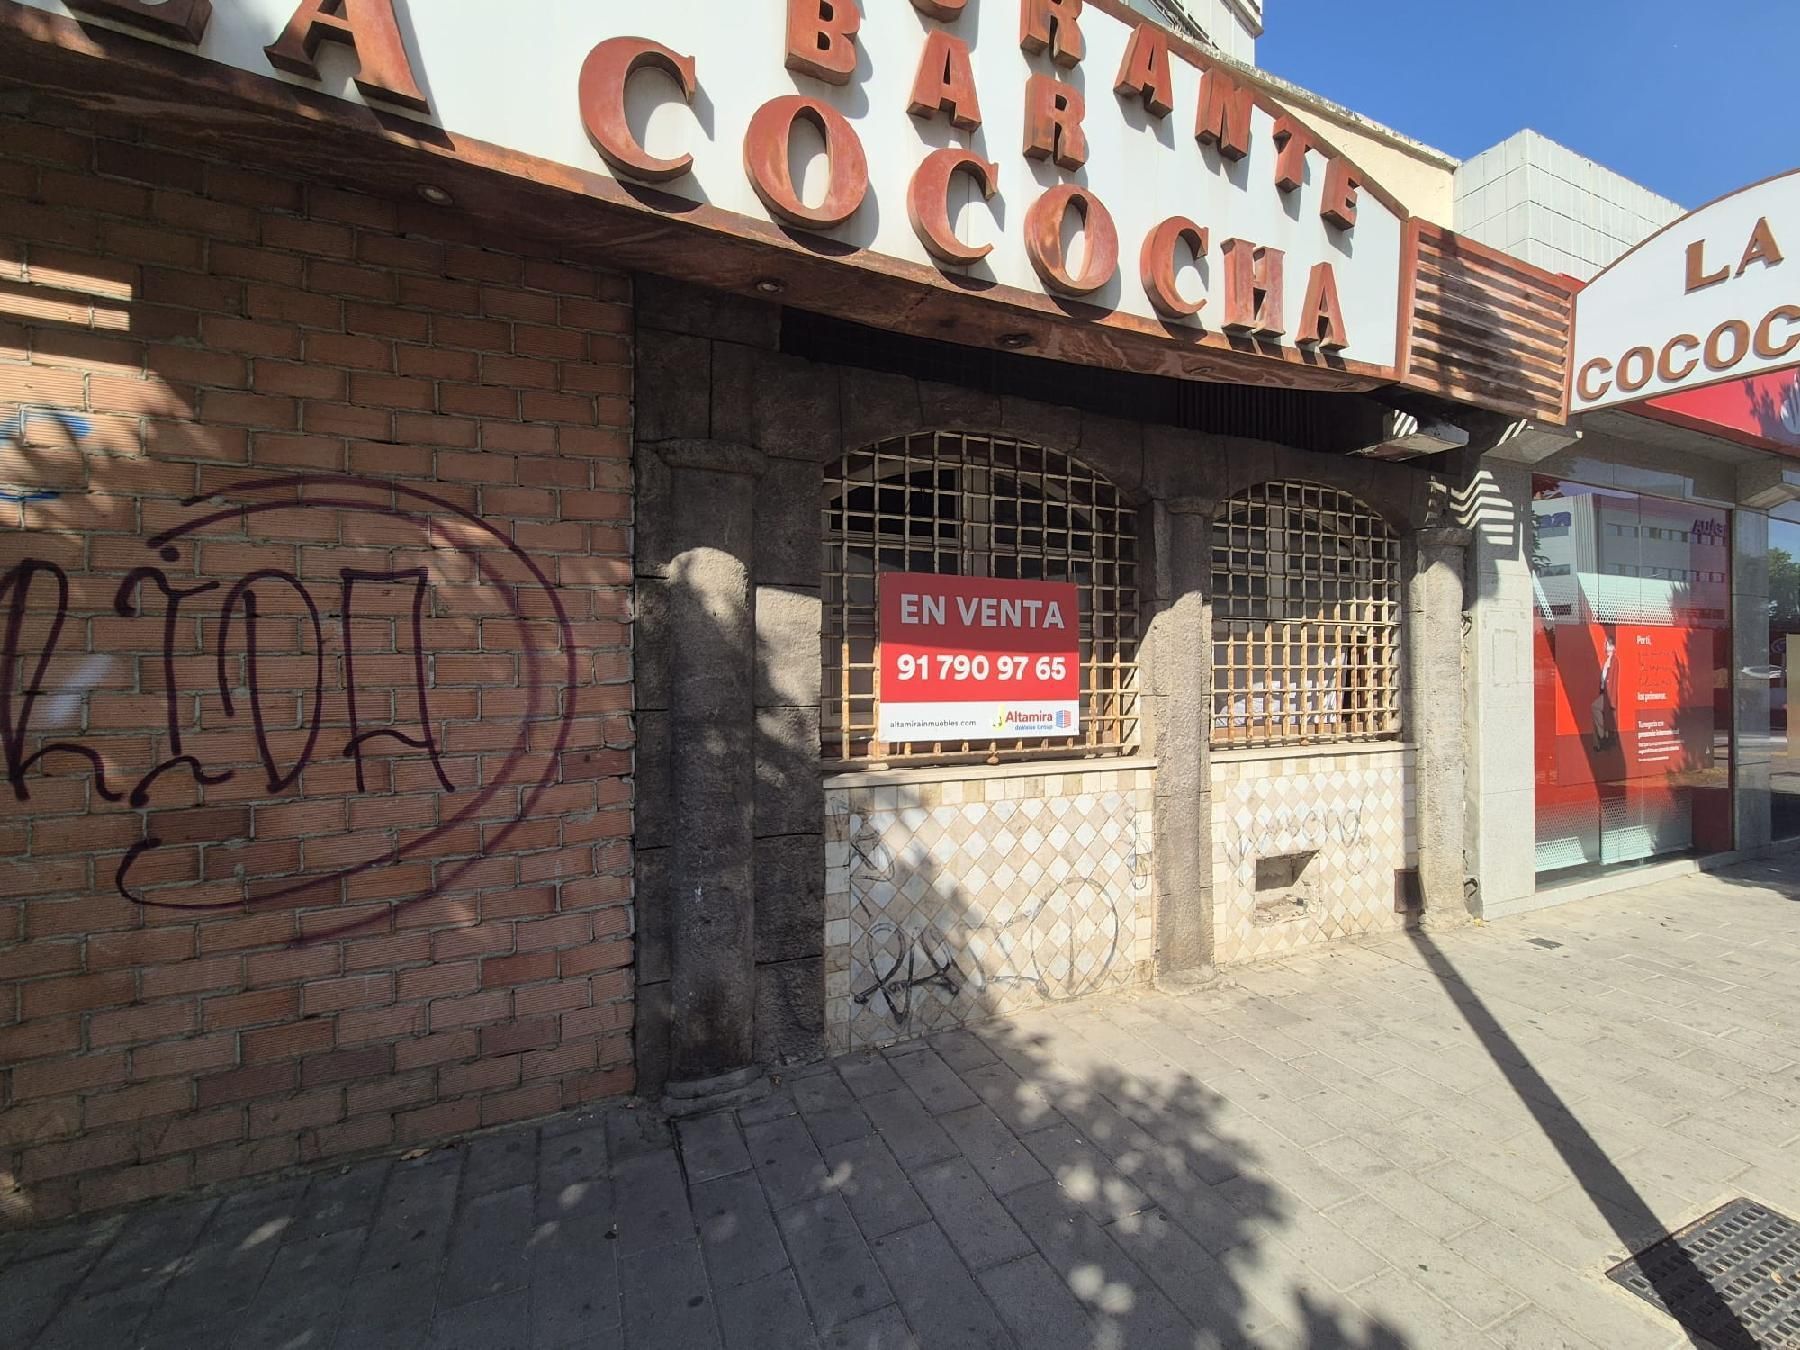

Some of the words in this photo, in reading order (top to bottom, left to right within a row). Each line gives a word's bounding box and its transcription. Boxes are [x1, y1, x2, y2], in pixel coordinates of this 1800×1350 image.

[785, 0, 1088, 172] BAR
[915, 0, 1366, 230] RANTE
[578, 36, 1349, 351] COCOCHA
[1685, 216, 1785, 295] LA
[901, 593, 946, 626] EN
[956, 596, 1065, 629] VENTA
[897, 654, 928, 680] 91
[937, 654, 990, 681] 790
[997, 655, 1029, 680] 97
[1035, 656, 1067, 681] 65
[890, 718, 977, 728] altamirainmuebles.com
[1005, 710, 1053, 722] Altamira
